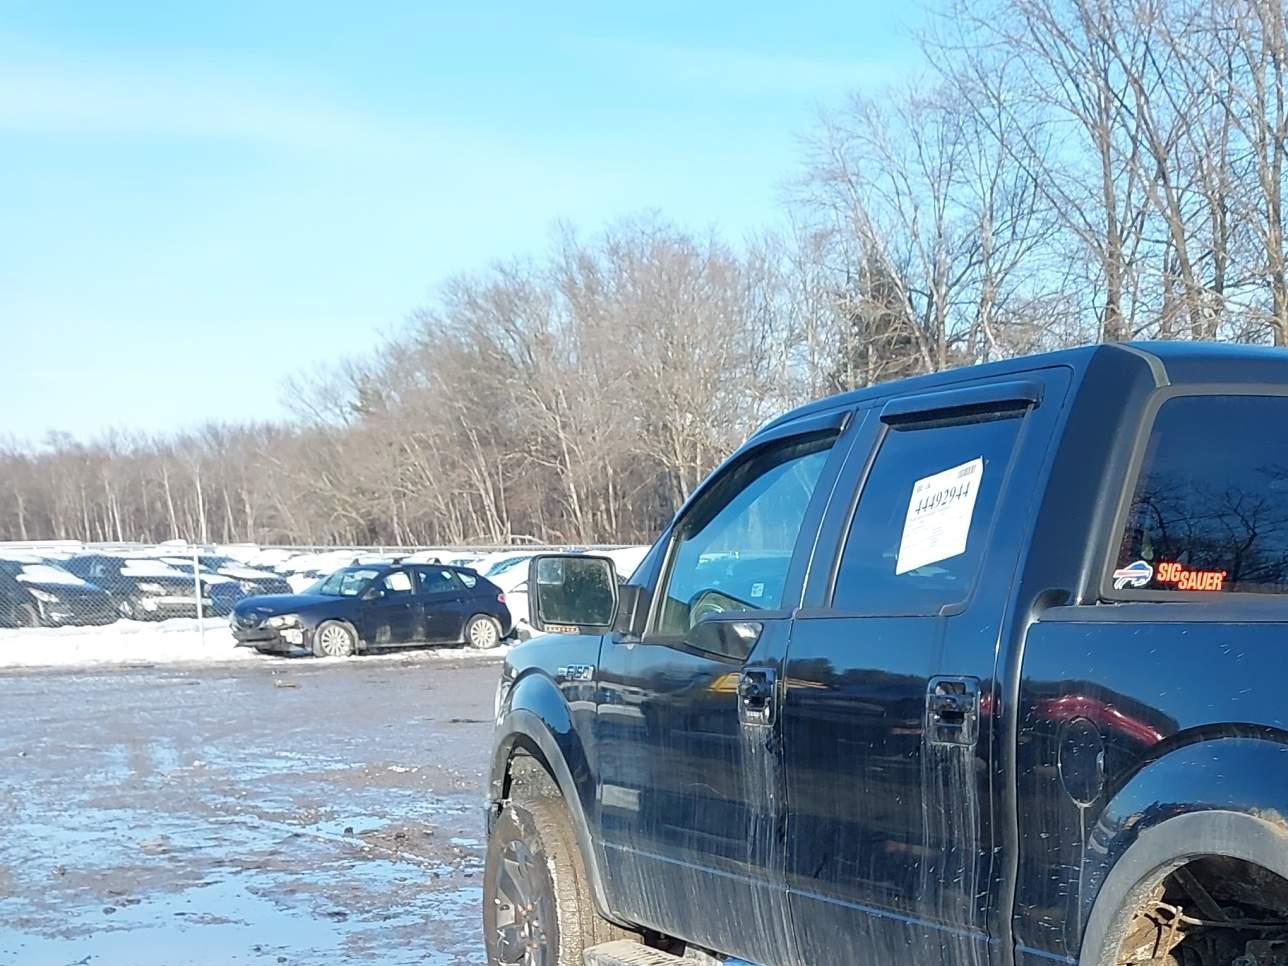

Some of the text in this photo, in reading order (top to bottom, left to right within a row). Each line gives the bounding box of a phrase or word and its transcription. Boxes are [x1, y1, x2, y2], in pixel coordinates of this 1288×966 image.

[915, 481, 971, 515] 44492944
[1157, 562, 1223, 590] SIG SAUER
